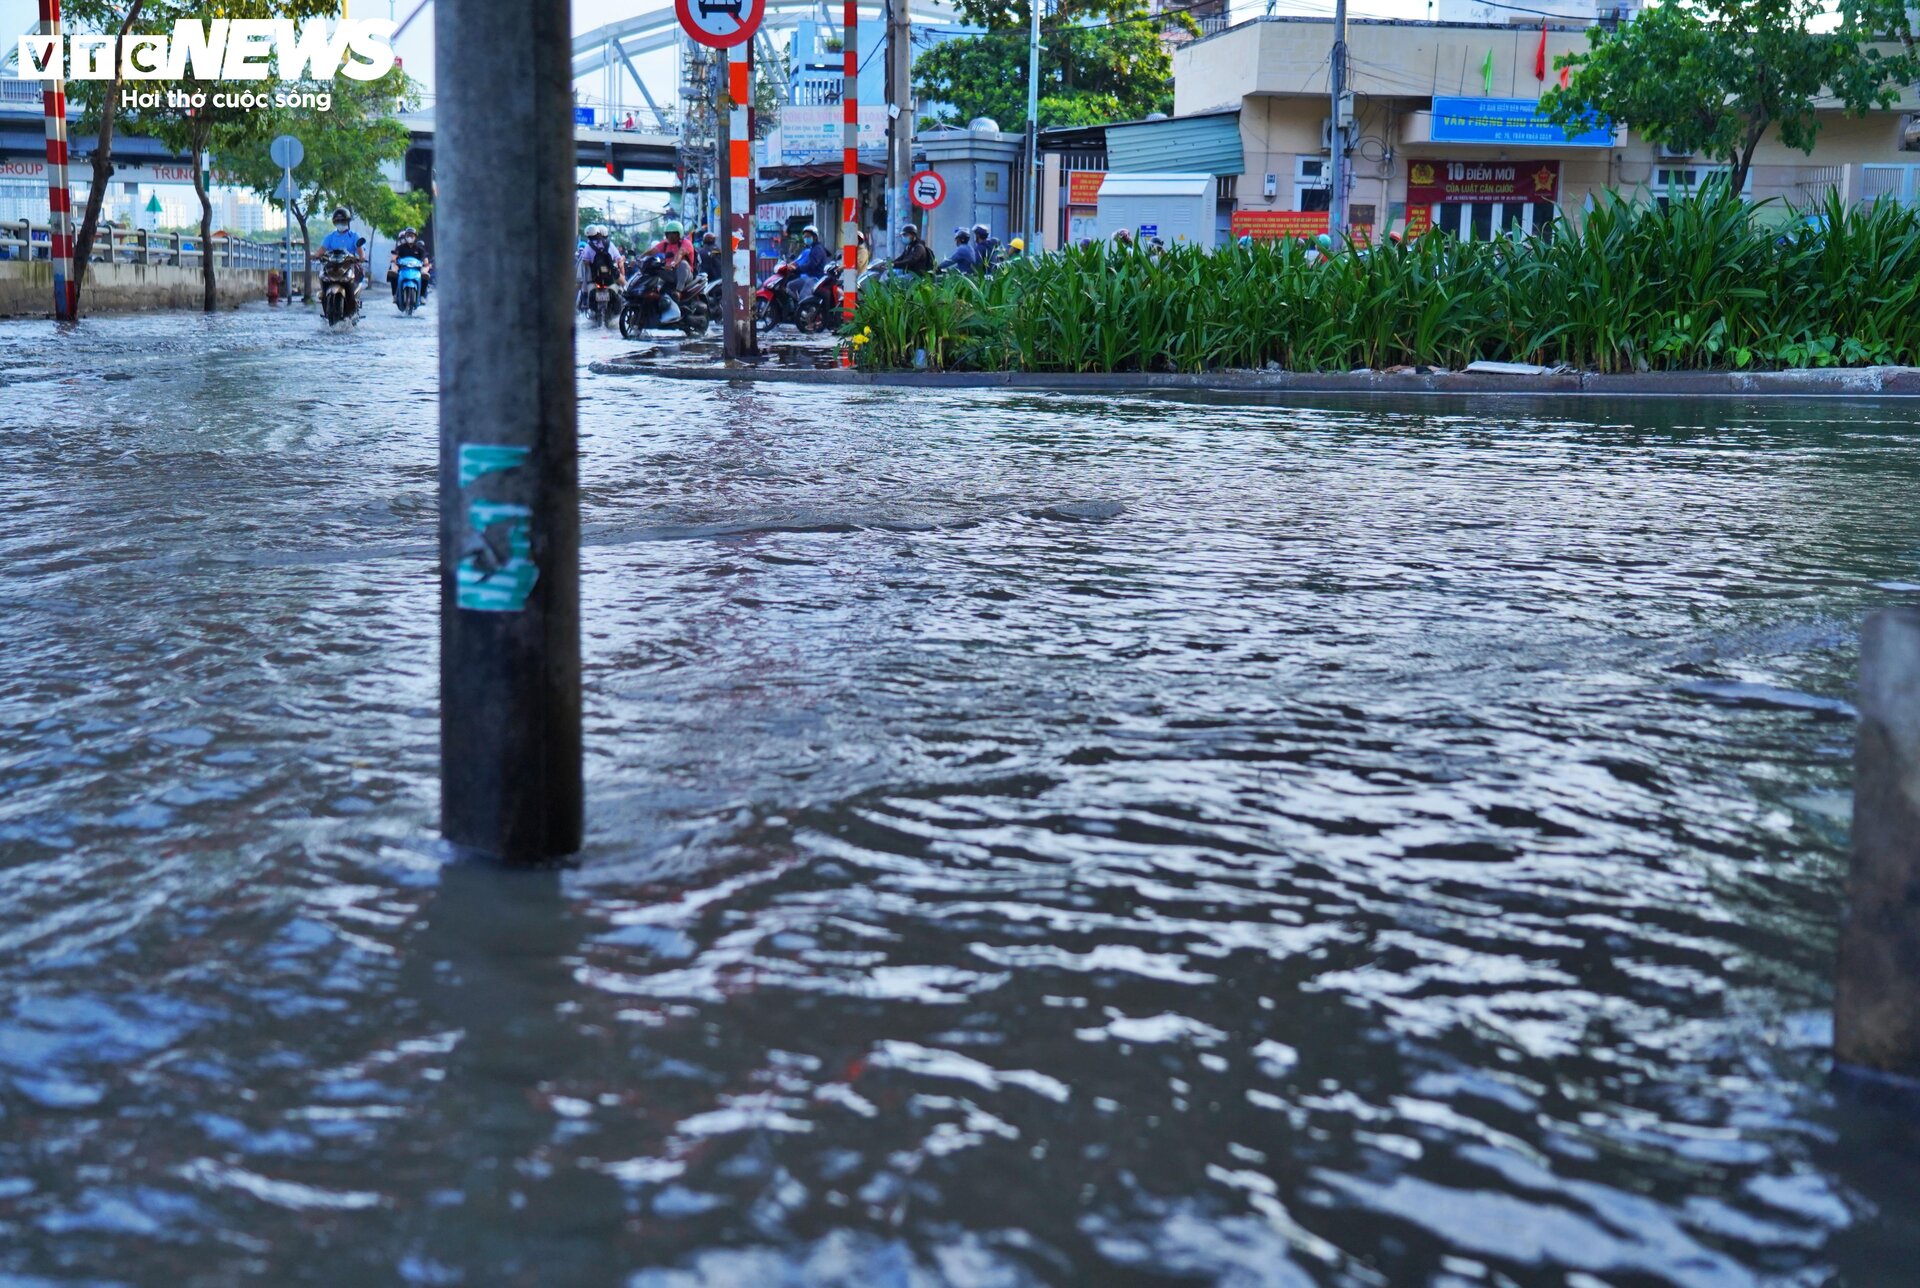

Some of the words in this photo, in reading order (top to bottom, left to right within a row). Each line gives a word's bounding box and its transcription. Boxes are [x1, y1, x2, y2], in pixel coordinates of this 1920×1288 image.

[1443, 114, 1465, 126] VĂN
[1506, 116, 1526, 128] KHU
[1446, 162, 1464, 181] 10
[1466, 163, 1492, 181] ĐIỂM
[1494, 165, 1516, 181] MỚI
[1445, 182, 1460, 193] CỦA
